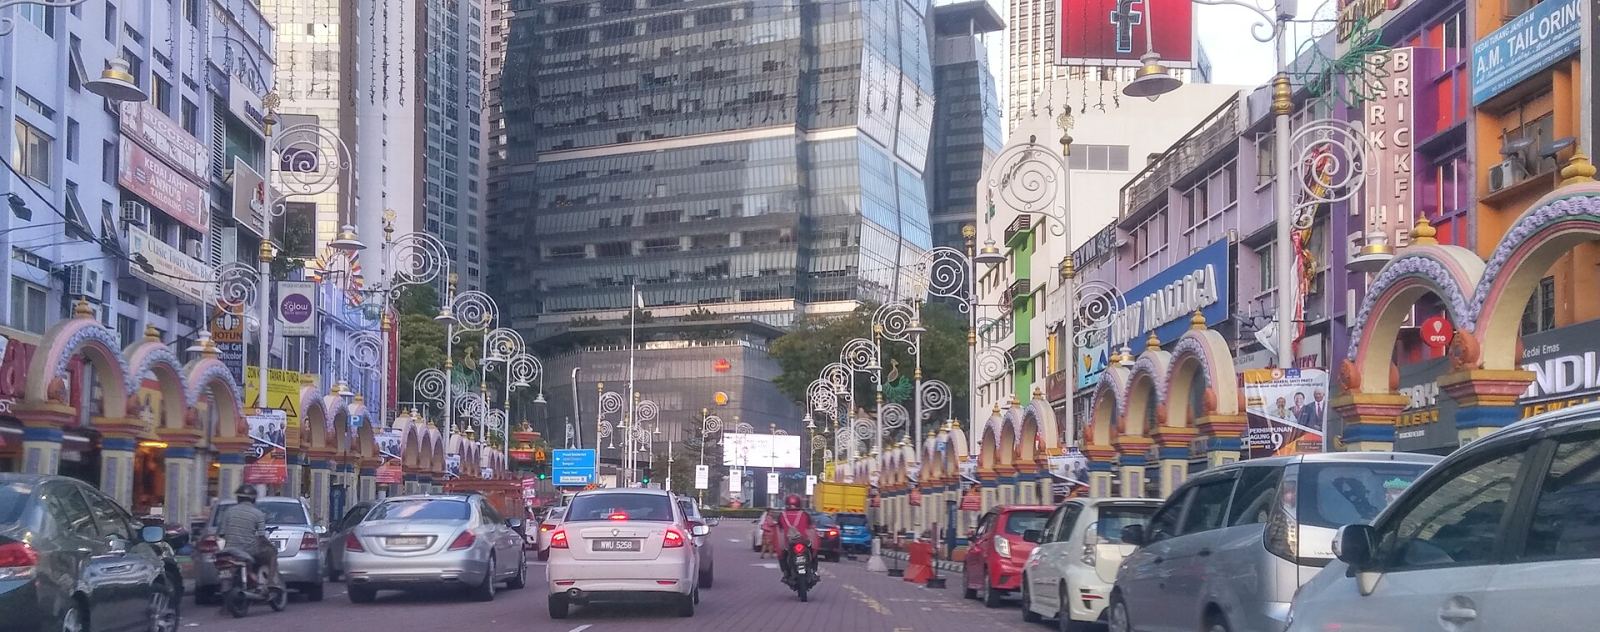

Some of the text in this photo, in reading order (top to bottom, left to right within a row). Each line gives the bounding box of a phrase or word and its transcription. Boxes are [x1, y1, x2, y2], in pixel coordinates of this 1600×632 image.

[1476, 45, 1503, 77] A.M.
[143, 109, 196, 155] SUCCESS
[144, 157, 167, 181] KEDAI
[168, 173, 189, 193] JAHIT
[1111, 301, 1141, 348] NEW
[213, 332, 241, 340] JOTUN
[1522, 343, 1560, 359] Kedai Emas
[350, 415, 360, 425] P
[1271, 432, 1284, 451] 9
[256, 446, 264, 459] 9
